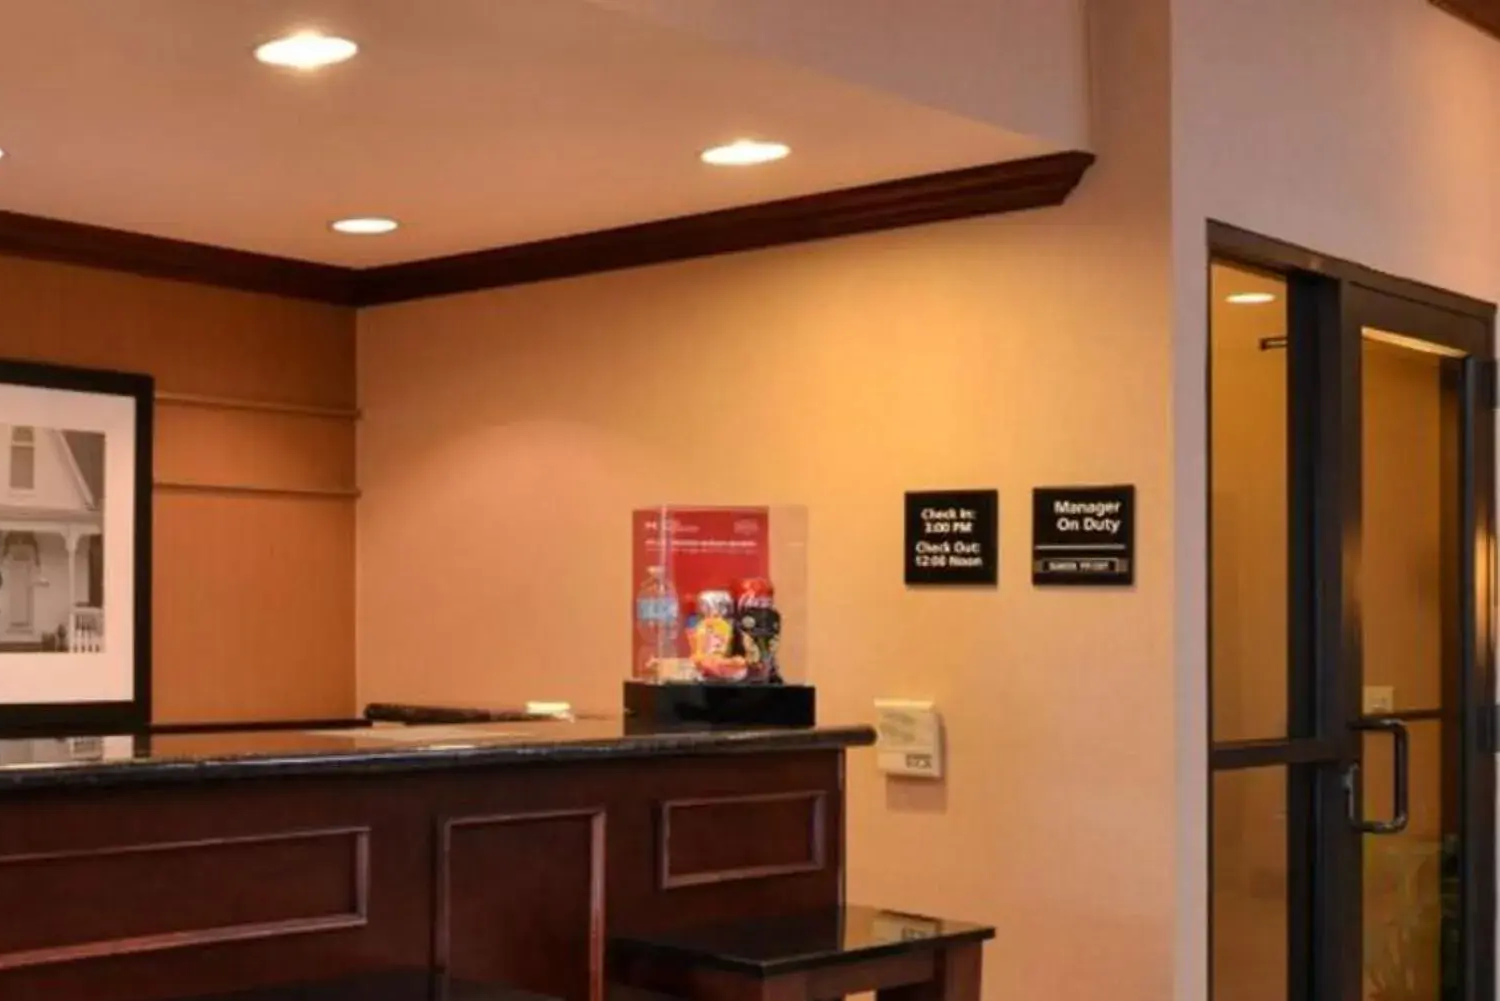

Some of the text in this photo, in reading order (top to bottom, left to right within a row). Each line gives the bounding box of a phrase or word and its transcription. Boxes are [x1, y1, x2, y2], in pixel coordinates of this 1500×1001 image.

[921, 508, 957, 520] Check
[1054, 501, 1121, 517] Manager
[953, 521, 973, 533] PM
[1056, 517, 1121, 534] On Duty
[915, 541, 950, 554] Check
[949, 555, 983, 567] Noon
